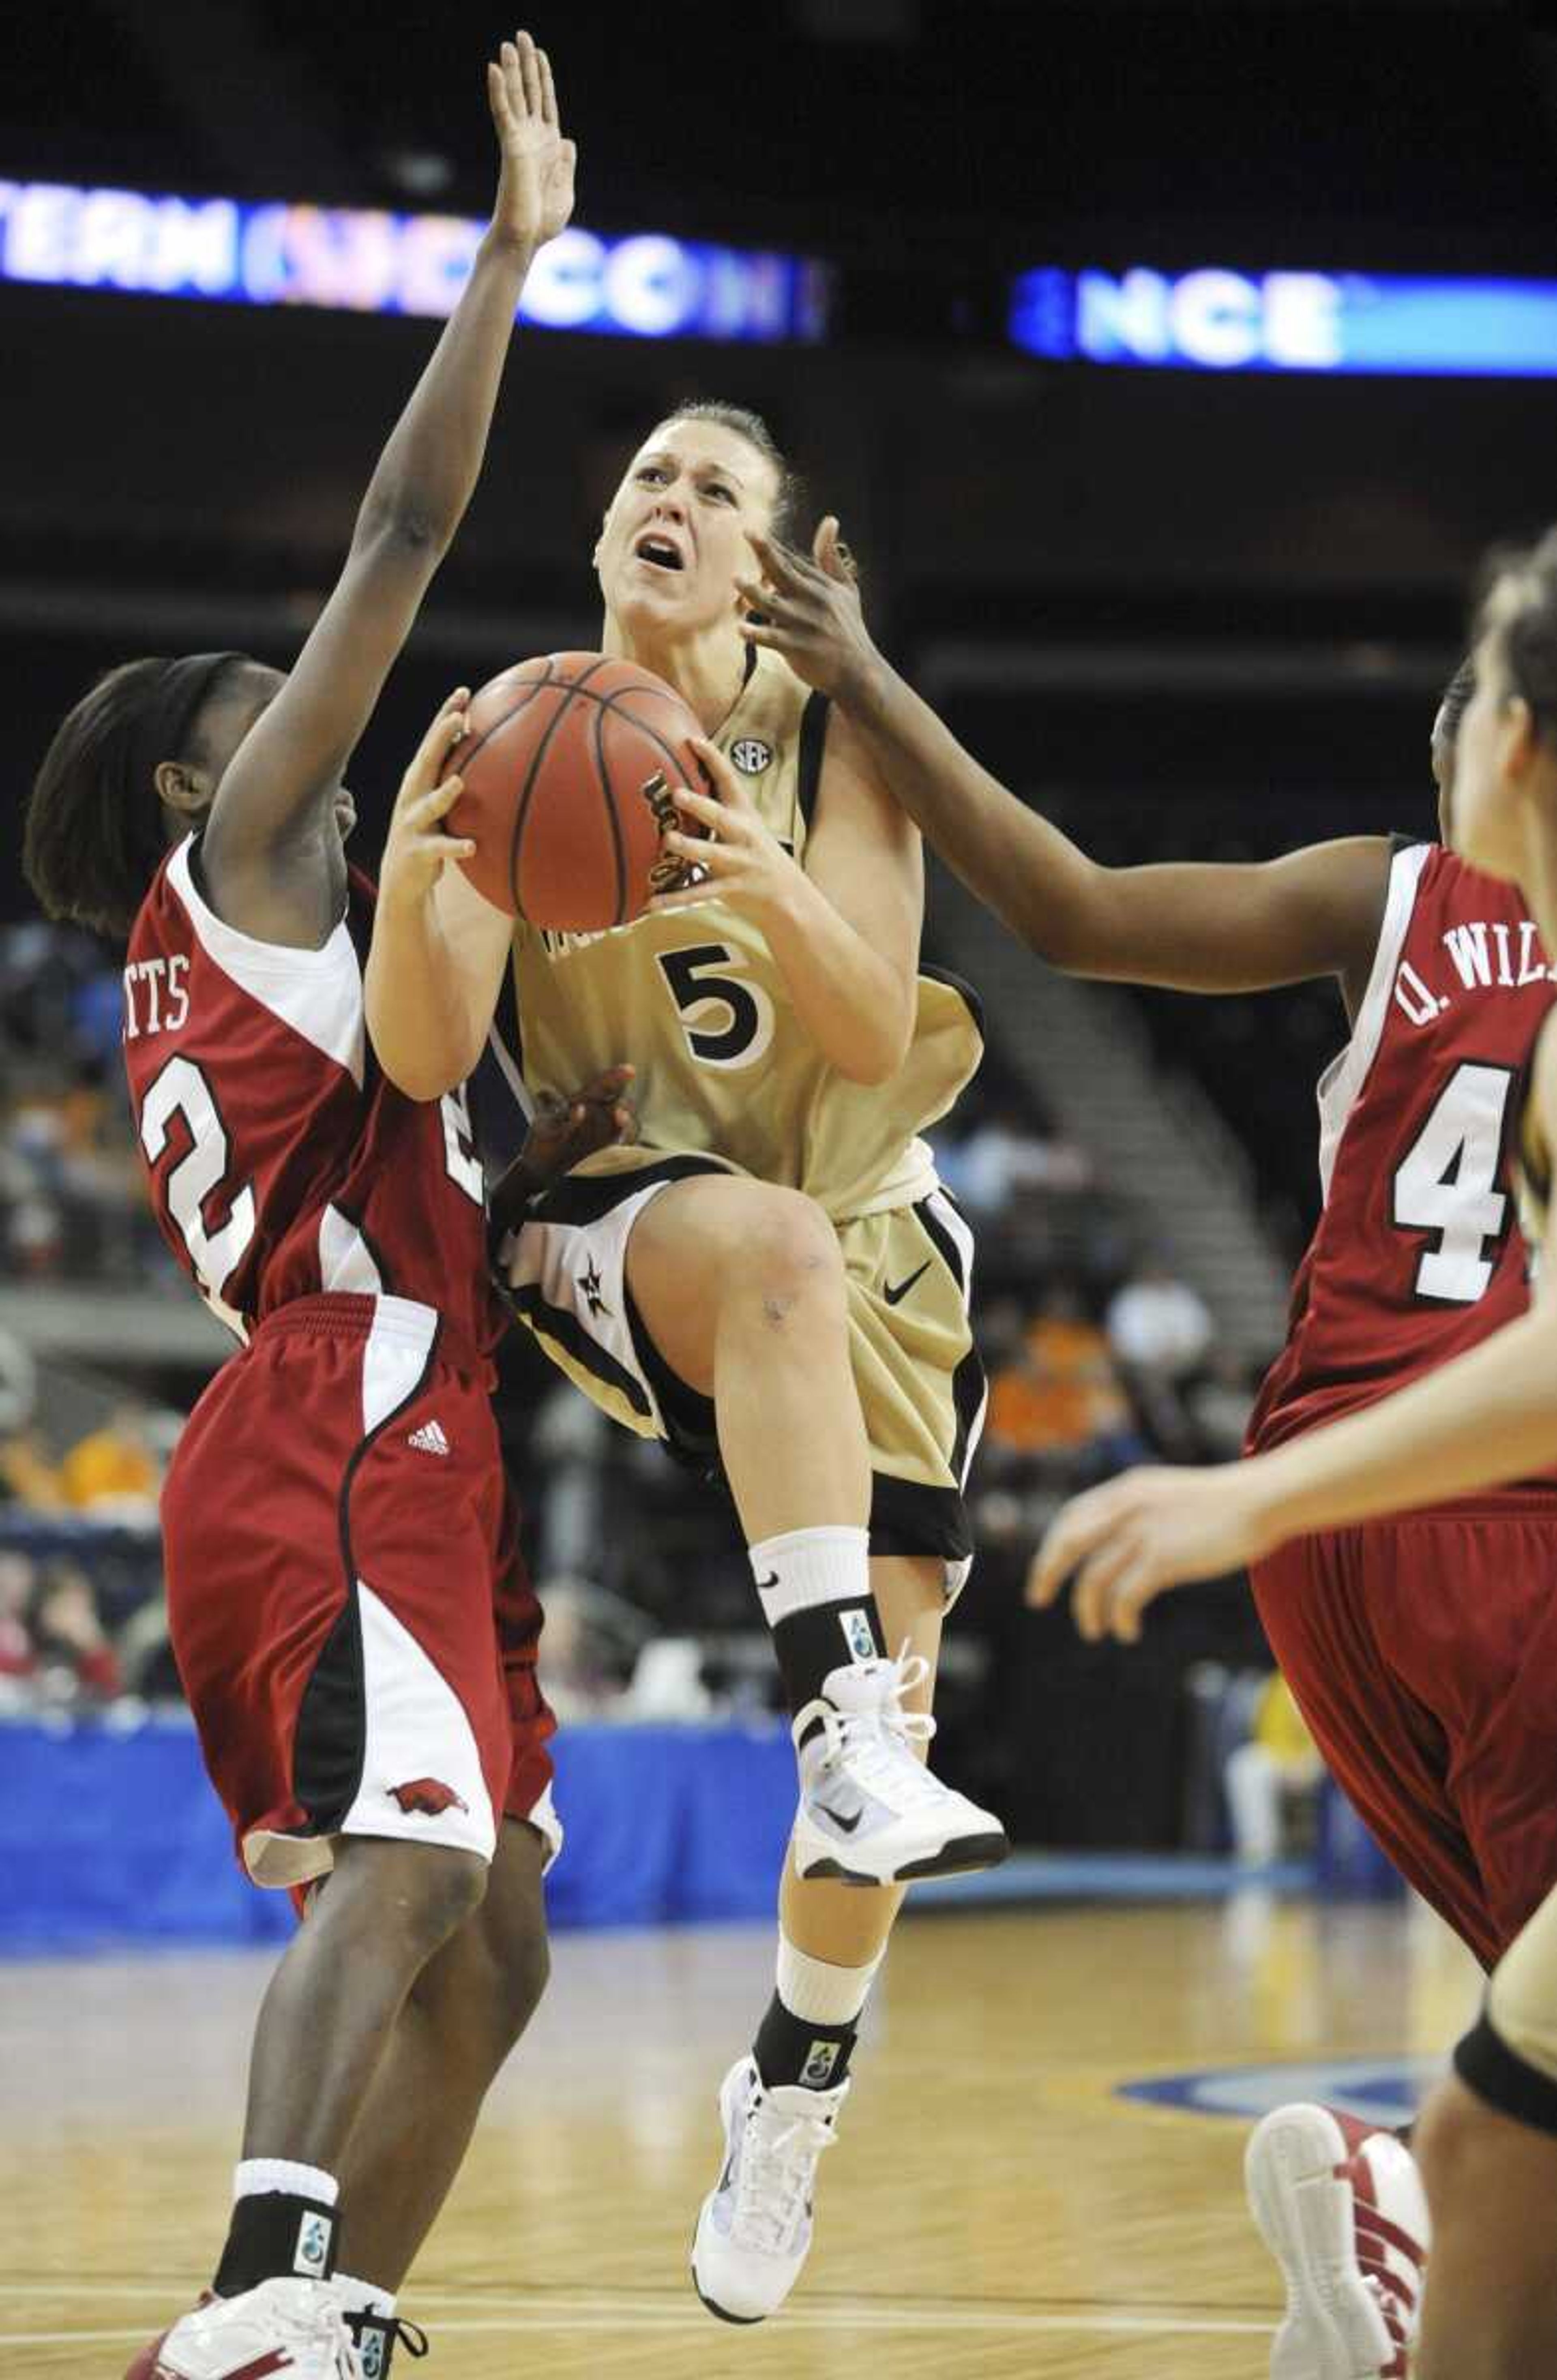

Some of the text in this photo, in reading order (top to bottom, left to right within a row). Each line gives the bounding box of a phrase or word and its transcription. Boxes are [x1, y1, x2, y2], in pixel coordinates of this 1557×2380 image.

[733, 741, 769, 772] SEC
[123, 954, 190, 1044] TTS
[654, 941, 775, 1071] 5
[141, 1055, 255, 1297] 2
[1394, 1063, 1512, 1302] 4
